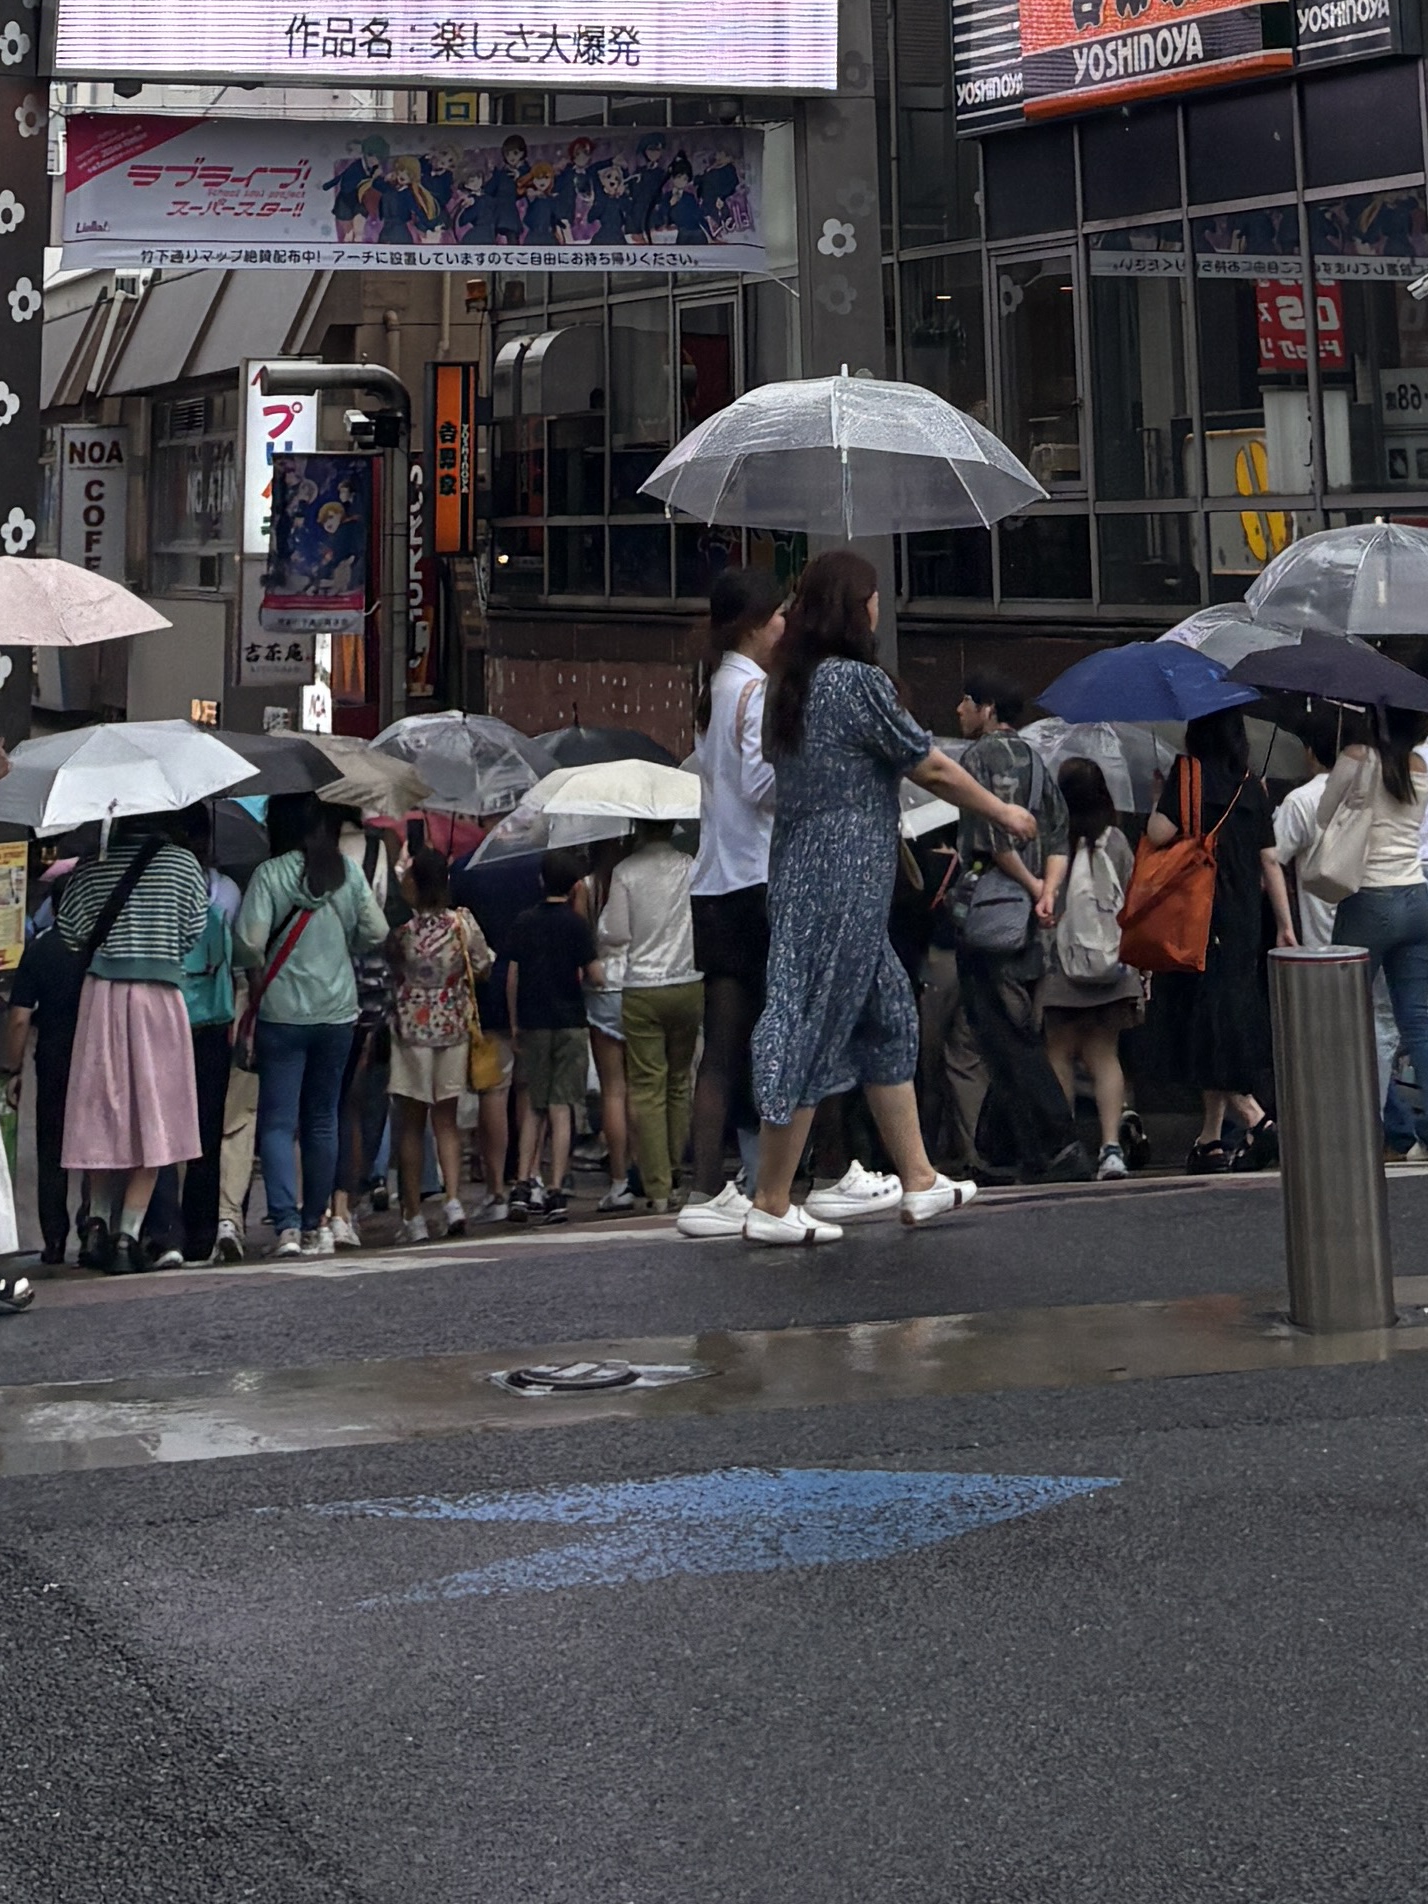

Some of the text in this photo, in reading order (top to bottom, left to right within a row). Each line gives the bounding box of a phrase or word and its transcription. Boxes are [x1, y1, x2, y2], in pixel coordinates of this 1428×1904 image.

[1073, 22, 1204, 84] YOSHINOYA
[956, 71, 1025, 106] YOSHINOYA
[69, 441, 124, 464] NOA
